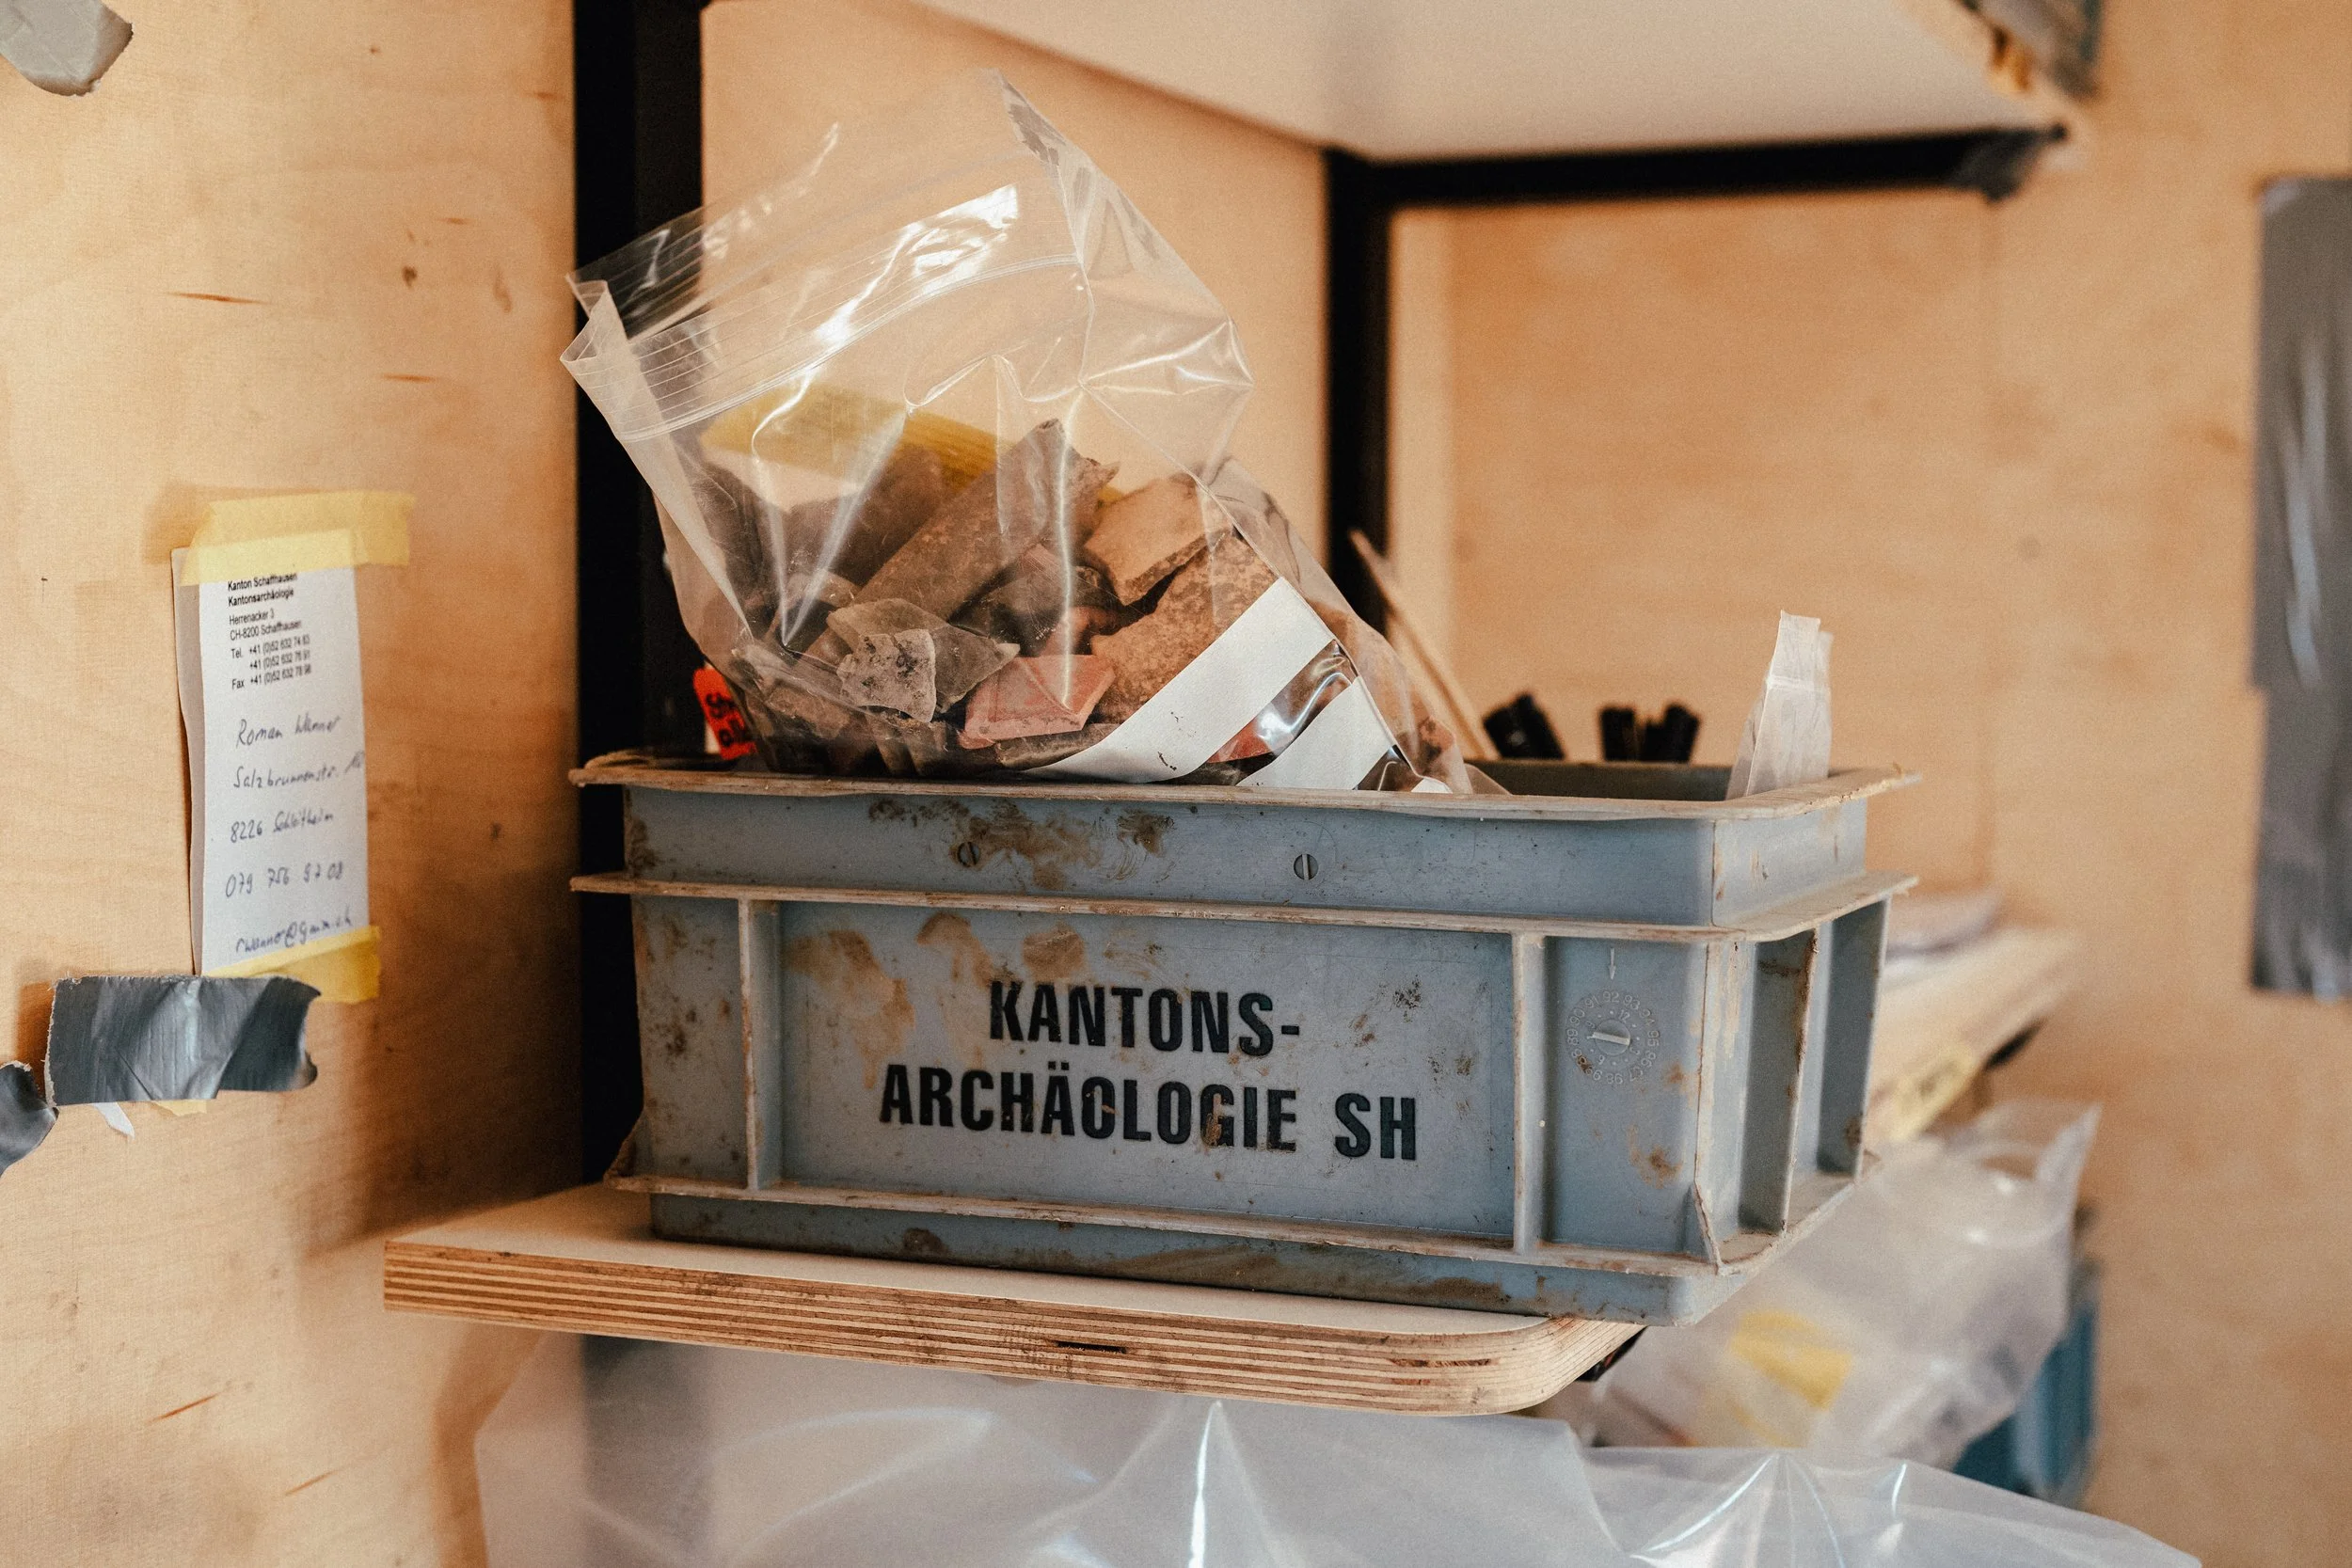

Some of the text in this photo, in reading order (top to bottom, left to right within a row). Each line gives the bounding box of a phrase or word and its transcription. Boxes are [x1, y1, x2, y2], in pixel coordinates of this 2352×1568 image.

[229, 573, 298, 592] Kanton Schaffhausen
[229, 588, 294, 607] Kantonsarchäologie
[230, 610, 268, 626] Herrenacker
[230, 621, 301, 641] CH-8200 Schaffhausen
[231, 648, 243, 658] Tel.
[249, 644, 261, 654] +41
[250, 659, 262, 670] +41
[231, 678, 245, 690] Fax
[250, 674, 262, 685] +41
[236, 719, 282, 748] Roman
[230, 819, 262, 844] 8226
[226, 873, 253, 898] 079
[989, 980, 1300, 1056] KANTONS-
[880, 1060, 1417, 1161] ARCHÄOLOGIE SH
